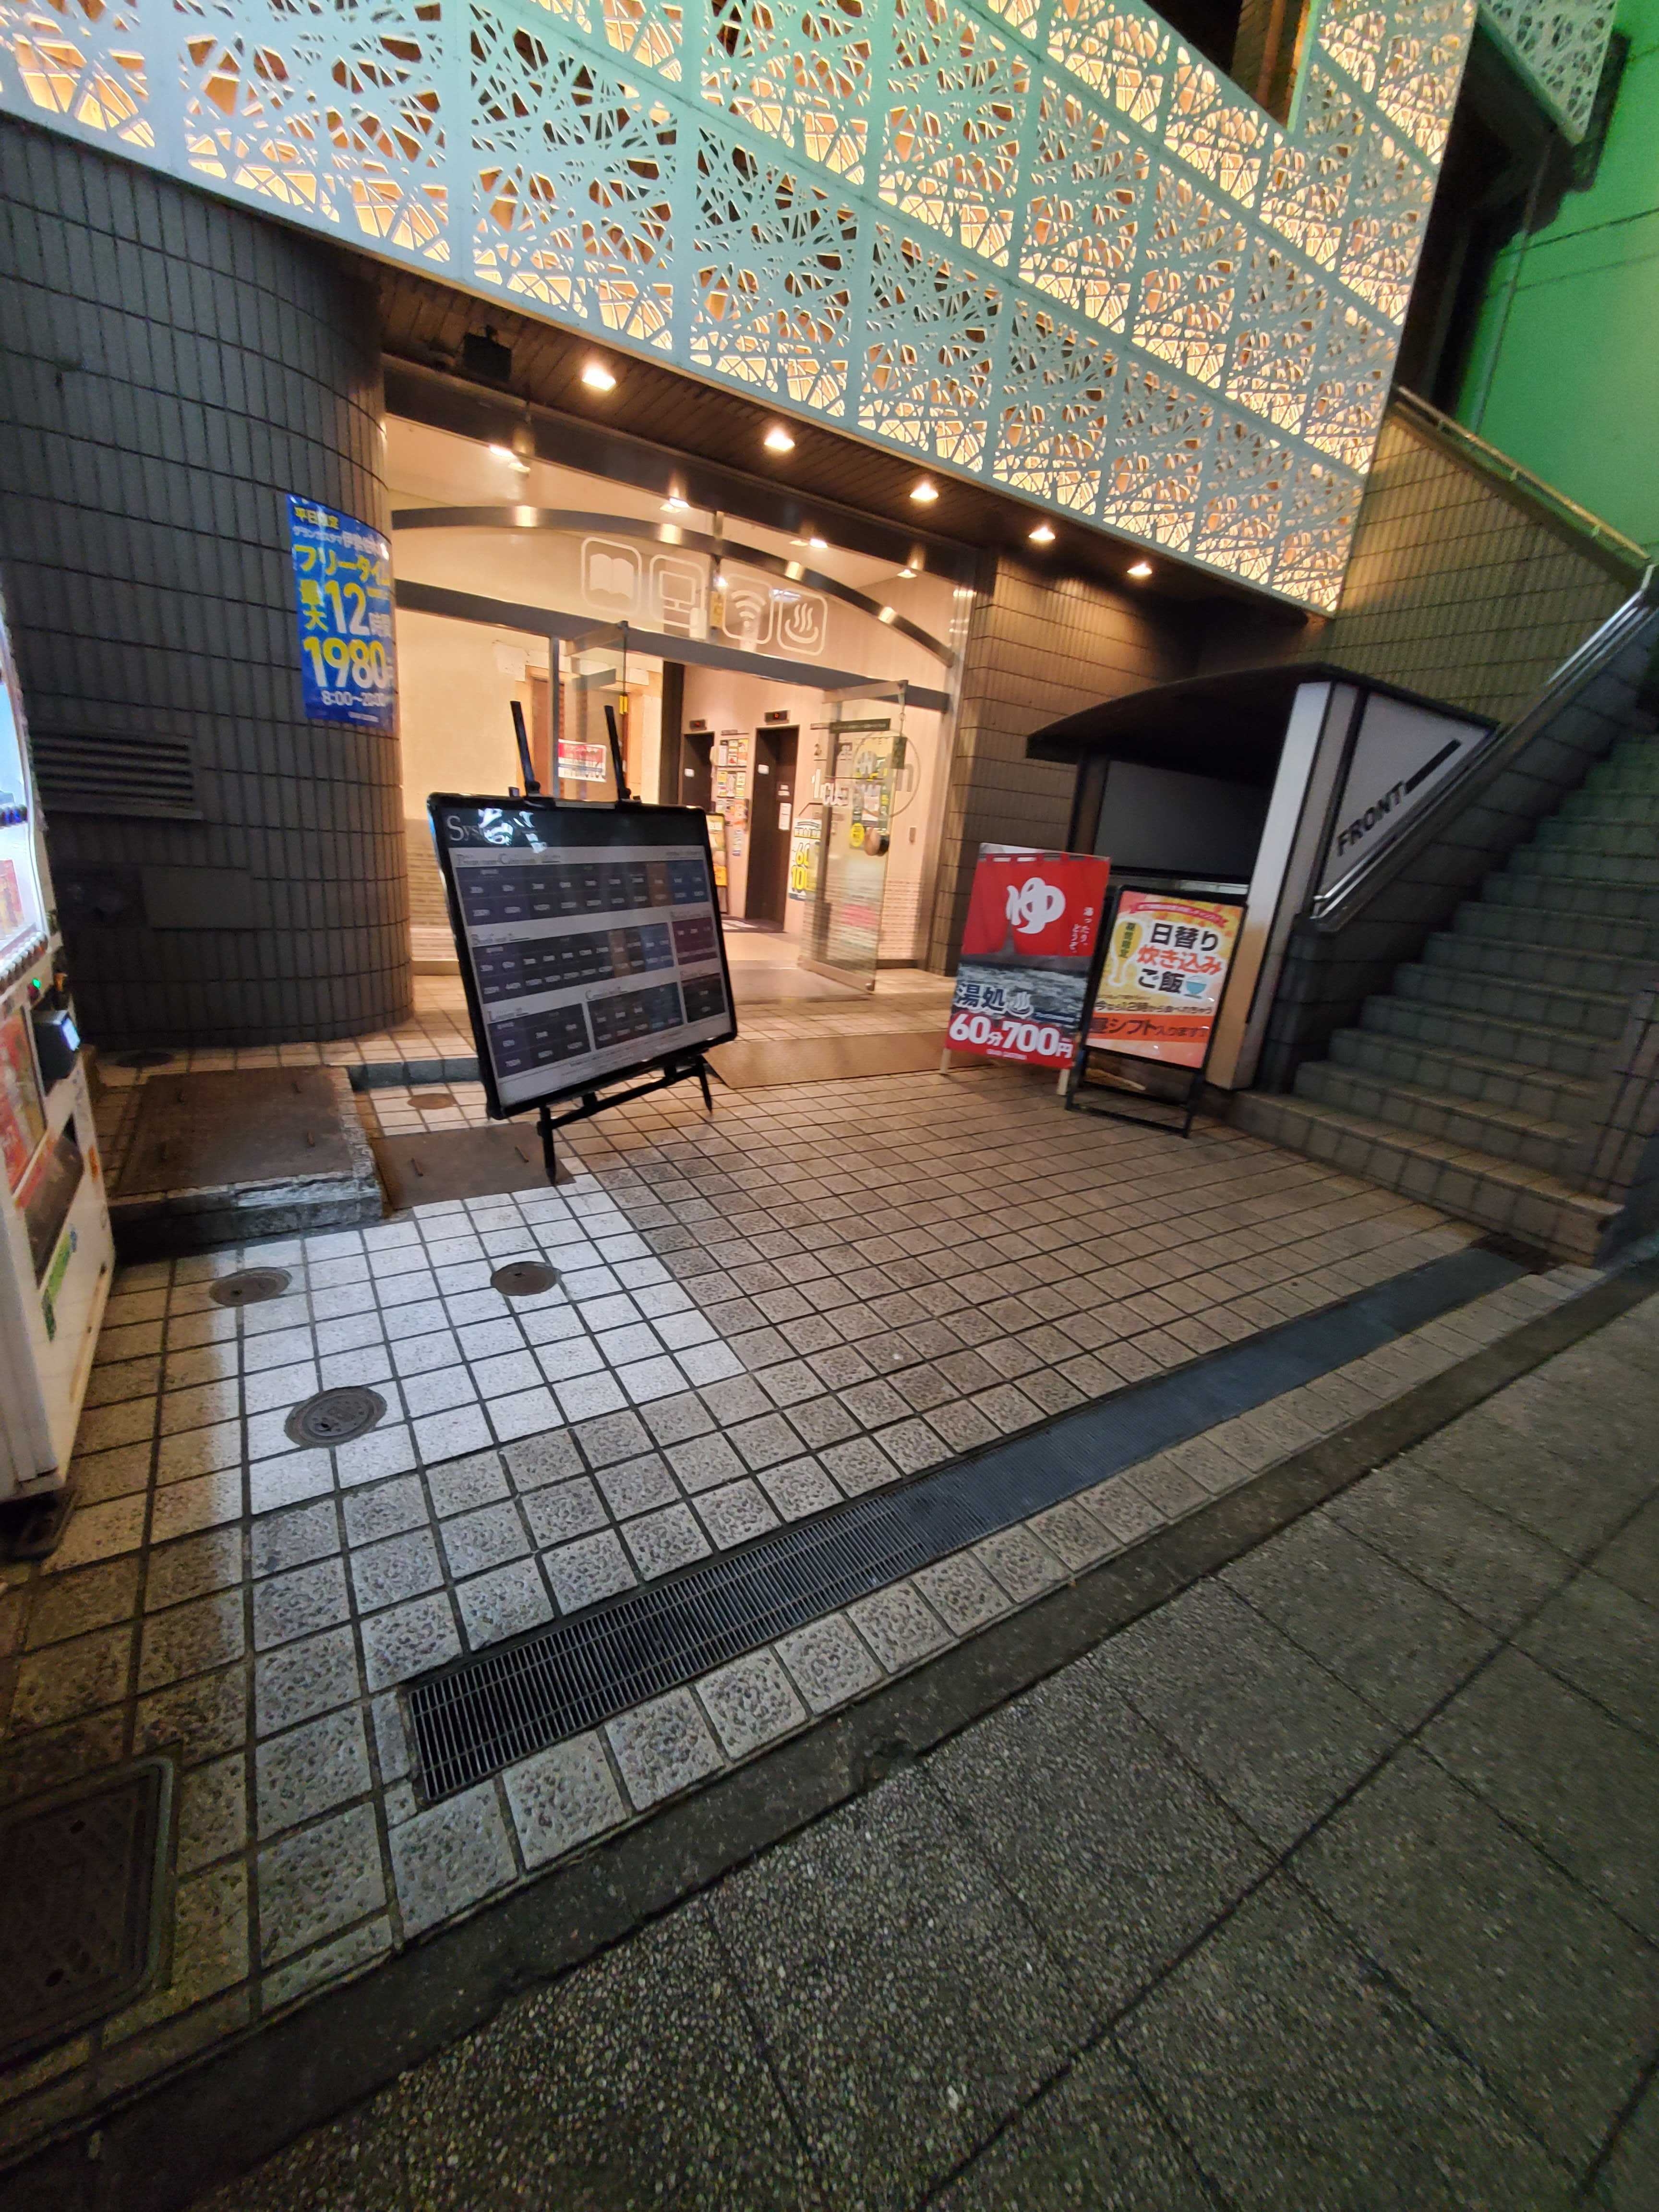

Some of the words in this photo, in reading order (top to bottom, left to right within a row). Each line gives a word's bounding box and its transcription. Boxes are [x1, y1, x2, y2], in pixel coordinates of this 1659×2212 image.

[1337, 780, 1403, 857] FRONT
[1006, 877, 1066, 934] ゆ
[1150, 923, 1219, 951] 日替り
[1136, 945, 1222, 975] 炊き込み
[1138, 968, 1185, 994] ご飯
[955, 983, 1006, 1012] 湯処
